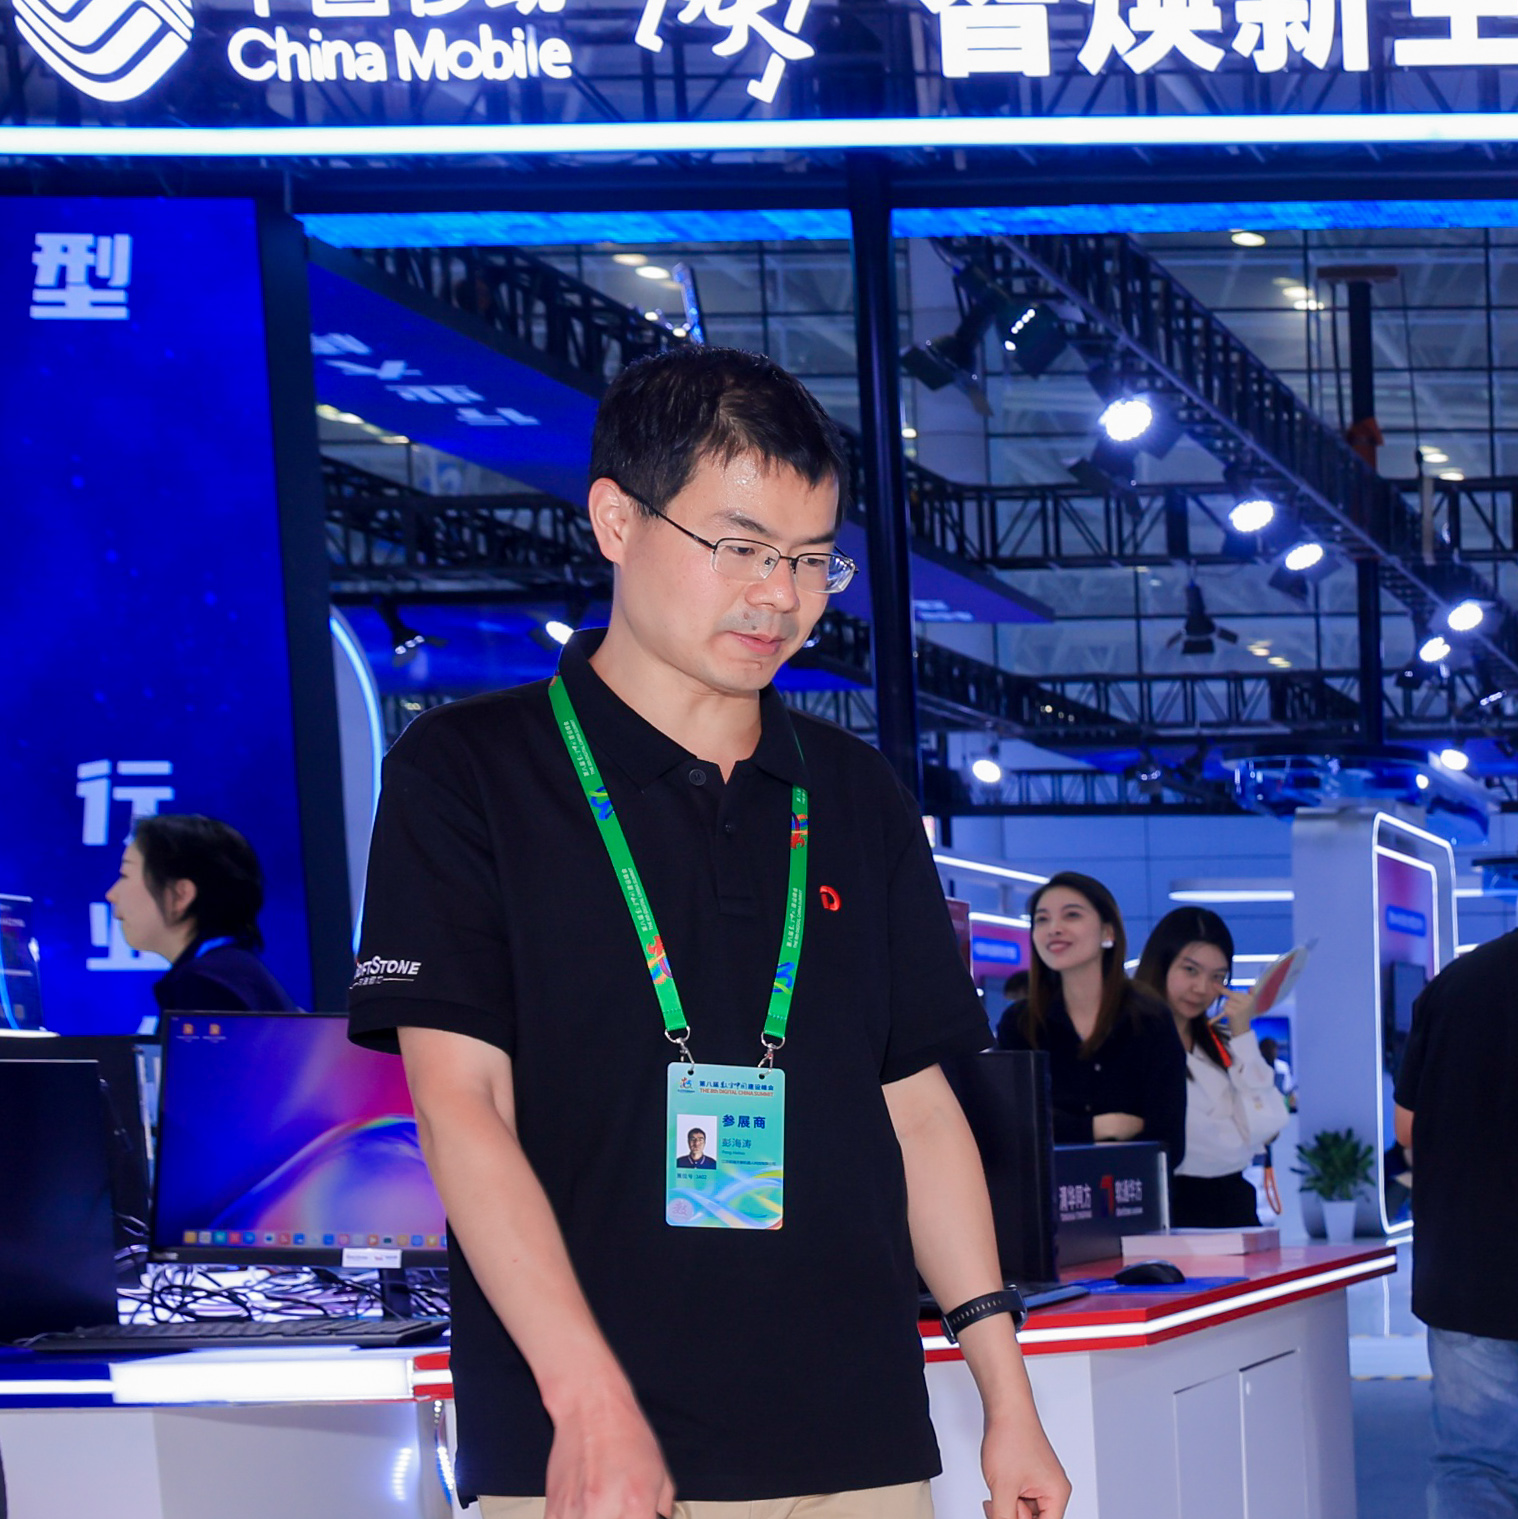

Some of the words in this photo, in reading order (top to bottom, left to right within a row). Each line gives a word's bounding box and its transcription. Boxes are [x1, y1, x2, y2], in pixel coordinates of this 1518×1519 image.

[227, 26, 388, 83] China
[394, 23, 572, 83] Mobile
[30, 234, 129, 318] 型
[722, 1114, 767, 1129] 参展商
